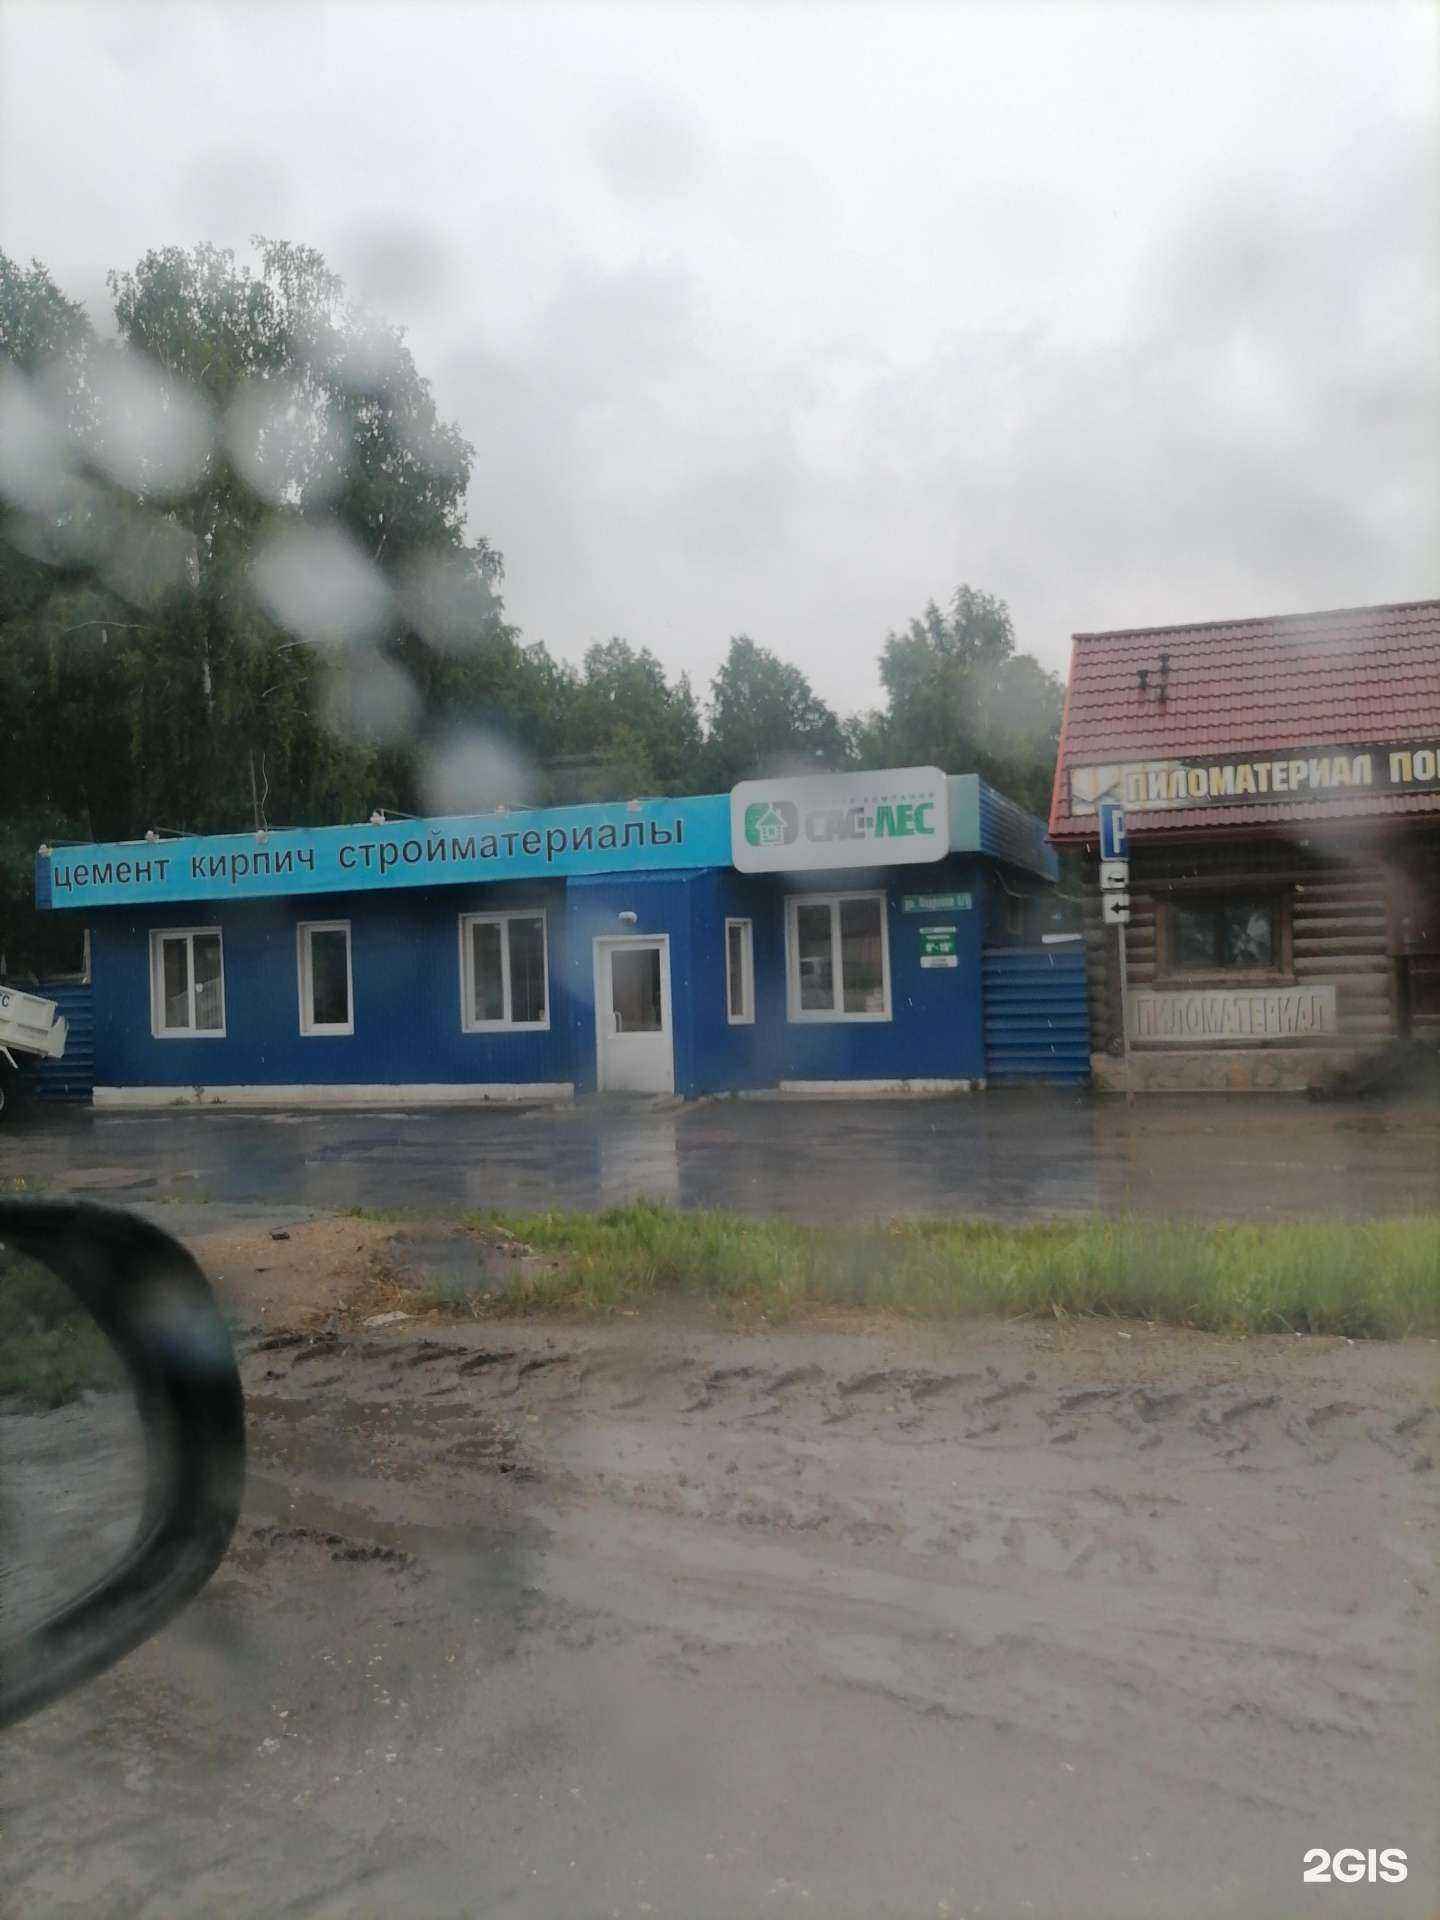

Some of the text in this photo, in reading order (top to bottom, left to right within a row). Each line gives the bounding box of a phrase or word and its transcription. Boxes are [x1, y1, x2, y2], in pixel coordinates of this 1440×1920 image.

[1127, 748, 1440, 801] ПИЛОМАТЕРИАЛ ПО
[53, 818, 684, 892] цемент кирпич стройматериалы
[1136, 994, 1324, 1035] ПИЛОМАТЕРИАЛ
